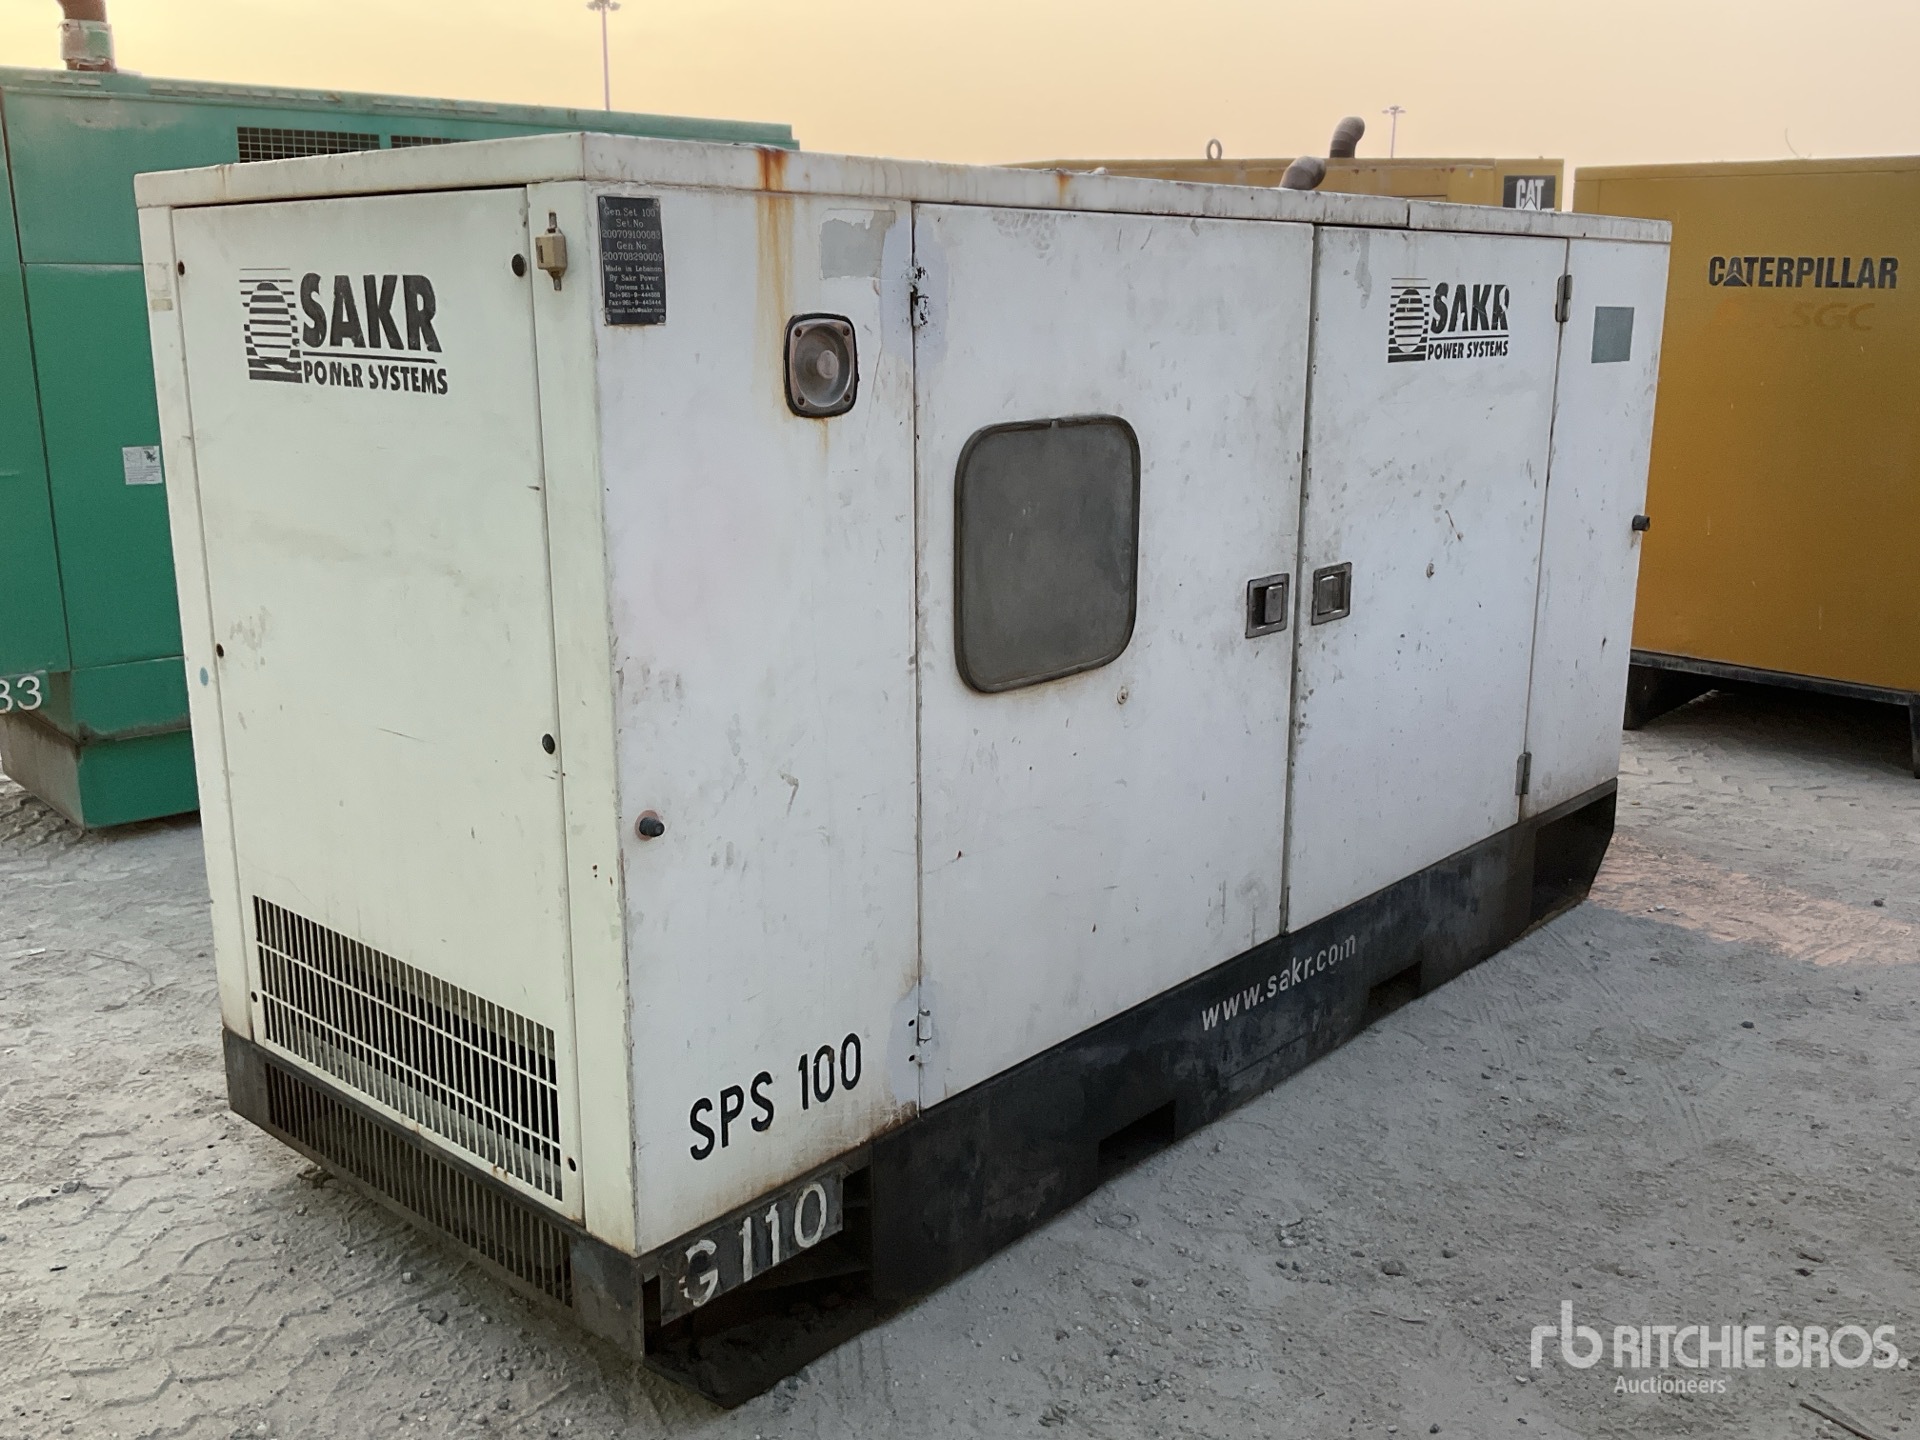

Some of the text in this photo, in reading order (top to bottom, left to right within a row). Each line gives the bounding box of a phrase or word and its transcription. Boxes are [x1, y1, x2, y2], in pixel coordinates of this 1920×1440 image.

[603, 207, 656, 218] Gen Set 100
[1515, 178, 1546, 210] CAT
[1708, 256, 1900, 289] CATERPILLAR
[300, 272, 443, 353] SAKR
[1430, 282, 1511, 334] SAKR
[1427, 340, 1509, 361] POWER SYSTEMS
[368, 364, 449, 395] SYSTEMS
[1202, 934, 1357, 1031] www.sakr.com
[690, 1032, 861, 1161] SPS 100
[738, 1183, 828, 1284] 110
